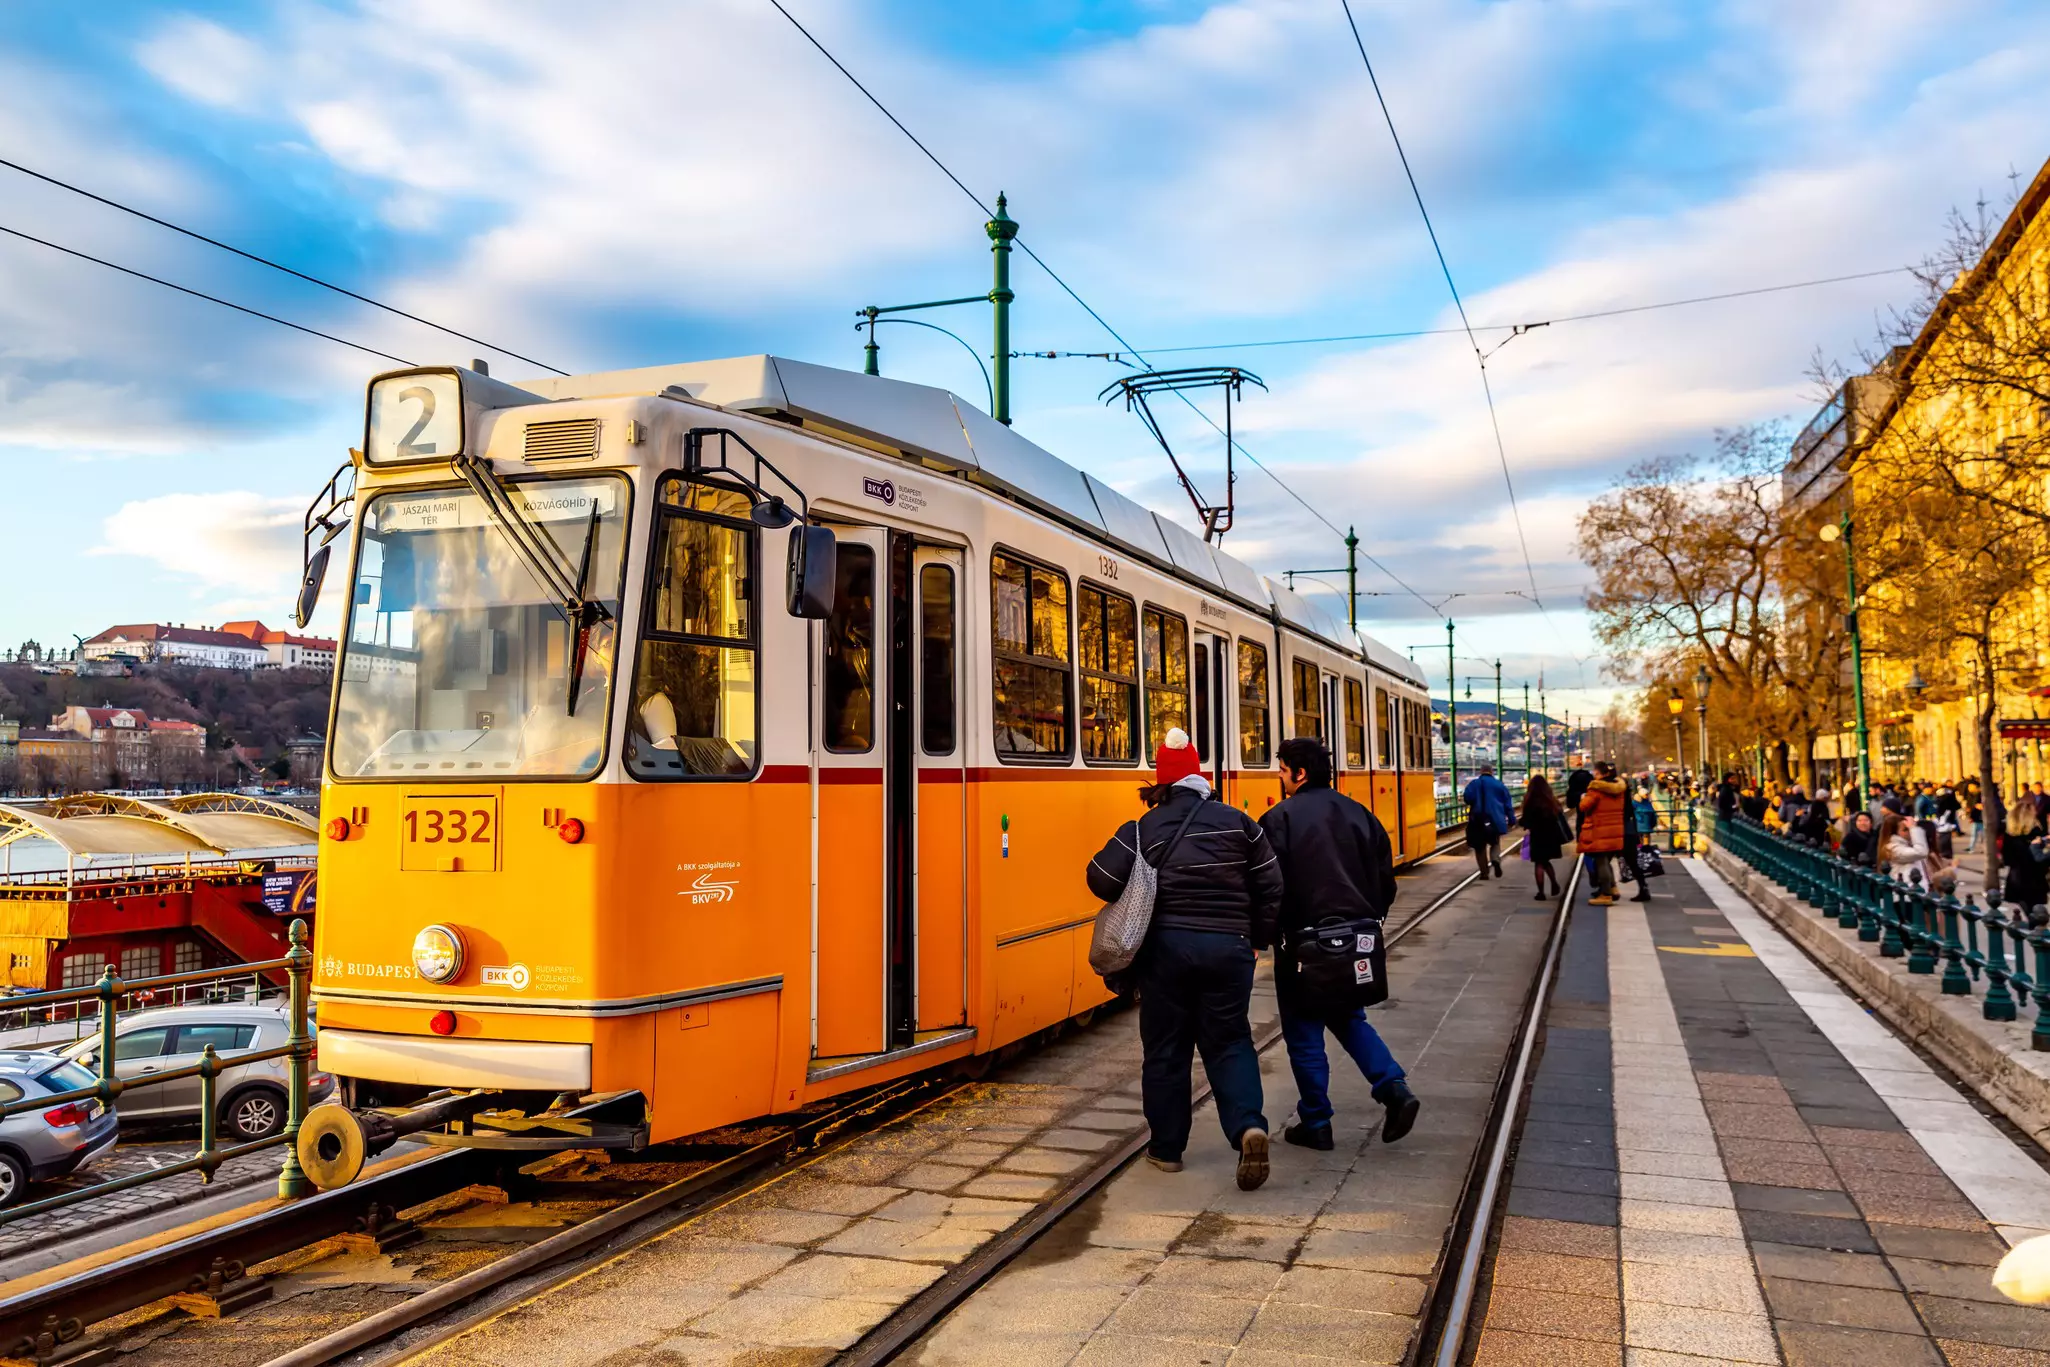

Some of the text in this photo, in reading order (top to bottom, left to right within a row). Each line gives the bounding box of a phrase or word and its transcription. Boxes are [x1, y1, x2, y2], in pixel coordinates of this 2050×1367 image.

[396, 386, 436, 457] 2
[867, 483, 882, 495] BKK
[402, 503, 457, 515] JÁSZAI MARI
[421, 514, 438, 525] TÉR
[1099, 555, 1119, 580] 1332
[405, 810, 490, 843] 1332
[683, 863, 697, 871] BKK
[692, 894, 710, 904] BKV
[347, 963, 420, 979] BUDAPEST
[535, 965, 575, 974] BUDAPESTI
[487, 971, 509, 981] BKK
